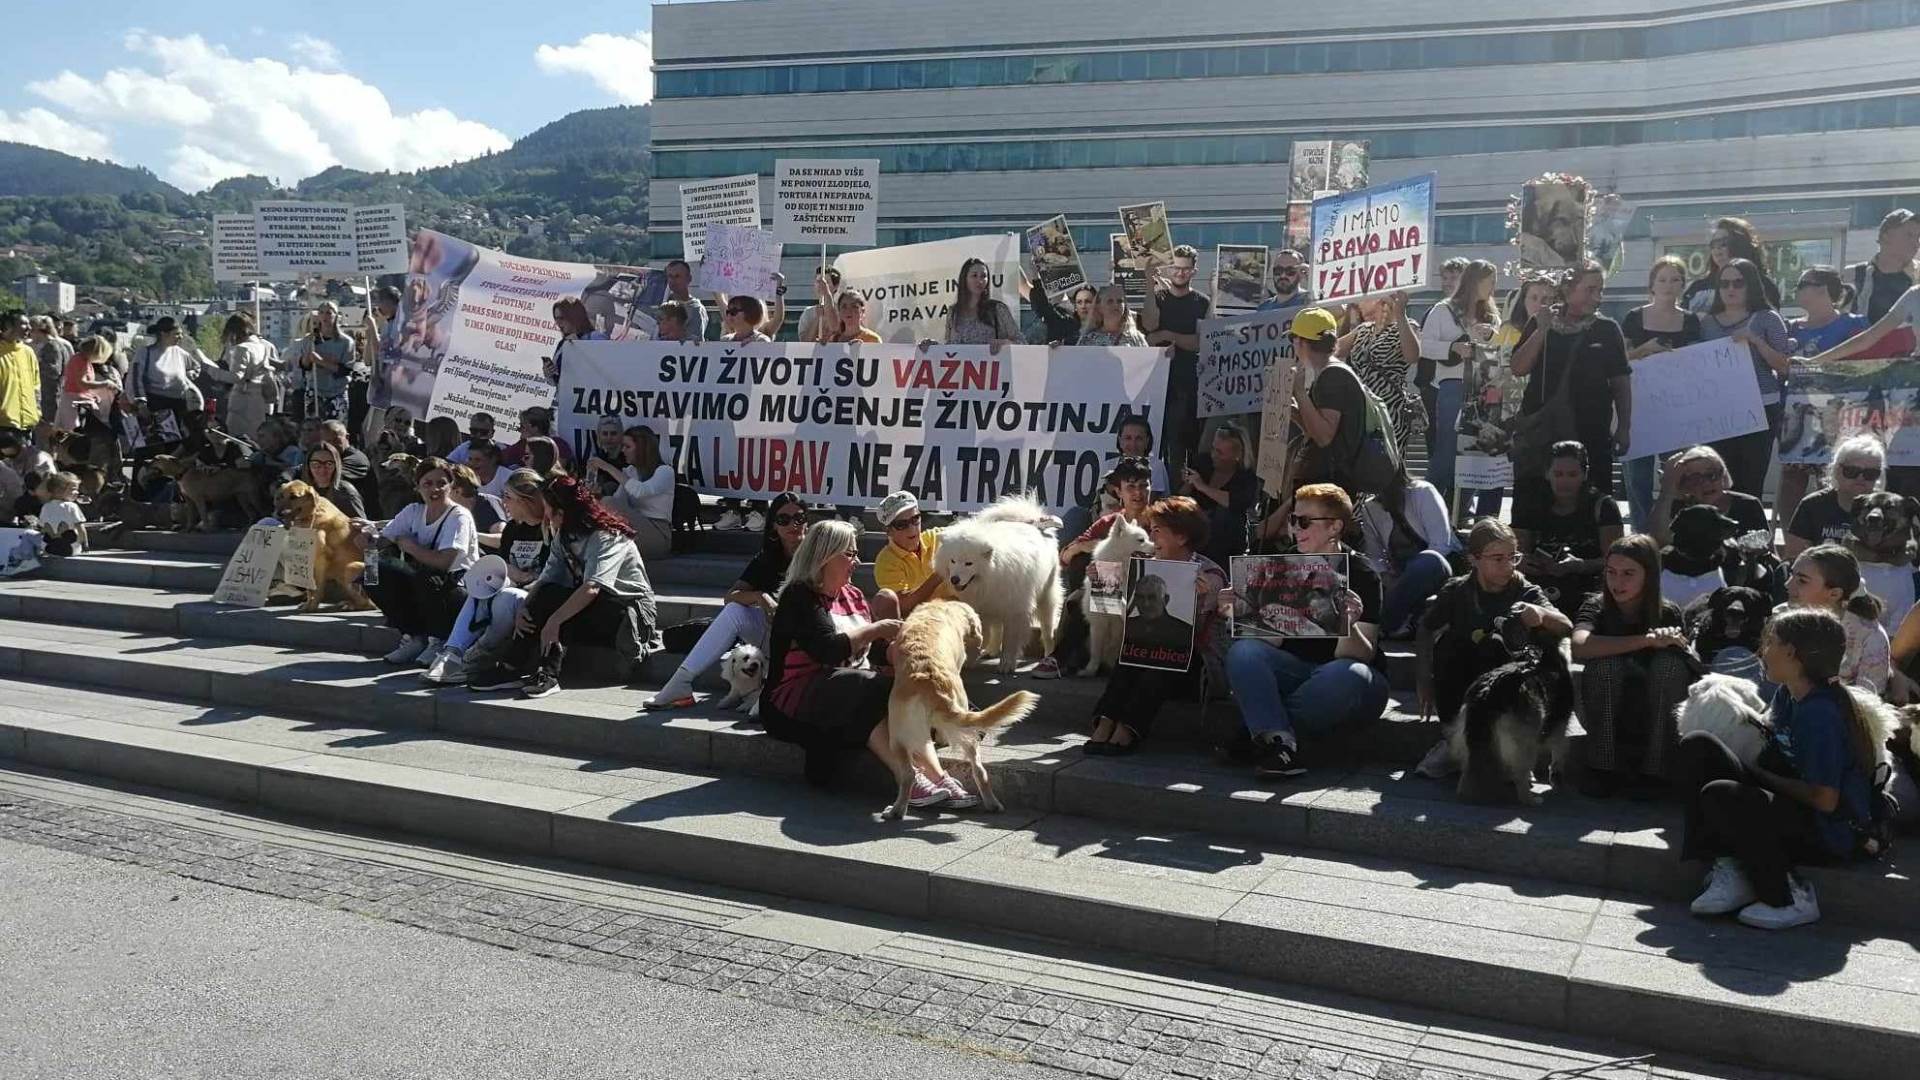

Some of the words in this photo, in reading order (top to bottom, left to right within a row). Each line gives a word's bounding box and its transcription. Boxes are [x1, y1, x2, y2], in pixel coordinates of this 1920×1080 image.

[789, 168, 801, 176] DA
[802, 168, 813, 176] SE
[813, 168, 842, 176] NIKAD
[844, 166, 865, 177] VIŠE
[781, 179, 793, 188] NE
[794, 179, 826, 188] PONOVI
[827, 180, 872, 189] ZLODJELO,
[778, 191, 818, 199] TORTURA
[819, 191, 823, 200] I
[784, 202, 797, 211] OD
[798, 202, 818, 212] KOJE
[818, 203, 828, 211] TI
[829, 203, 847, 211] NISI
[848, 203, 865, 211] BIO
[837, 214, 856, 223] NITI
[1321, 233, 1381, 264] PRAVO
[1388, 225, 1420, 251] NA
[492, 293, 536, 311] ŽIVOTINJA!
[461, 303, 486, 315] DANAS
[486, 309, 503, 319] SMO
[503, 312, 513, 321] MI
[513, 313, 541, 327] MEDIN
[464, 318, 470, 328] U
[470, 319, 485, 330] IME
[485, 323, 505, 334] ONIH
[505, 326, 522, 340] KOJI
[523, 330, 556, 347] NEMAJU
[495, 340, 518, 353] GLAS!
[472, 359, 479, 368] bi
[479, 360, 490, 371] bio
[510, 368, 534, 381] mjesto
[658, 355, 709, 383] SVI
[716, 349, 822, 386] ŽIVOTI
[833, 358, 879, 388] SU
[892, 352, 1010, 399] VAŽNI,
[443, 366, 453, 374] svi
[452, 367, 470, 382] ljudi
[468, 372, 490, 385] poput
[489, 377, 506, 388] pasa
[506, 381, 526, 394] mogli
[525, 385, 550, 399] voljeti
[1225, 373, 1264, 395] UBIJ
[454, 409, 467, 419] pod
[476, 402, 485, 410] za
[485, 403, 504, 415] mene
[504, 407, 518, 418] nije
[572, 387, 749, 421] ZAUSTAVIMO
[759, 388, 923, 427] MUČENJE
[713, 436, 834, 496] LJUBAV,
[847, 442, 892, 498] NE
[901, 444, 943, 501] ZA
